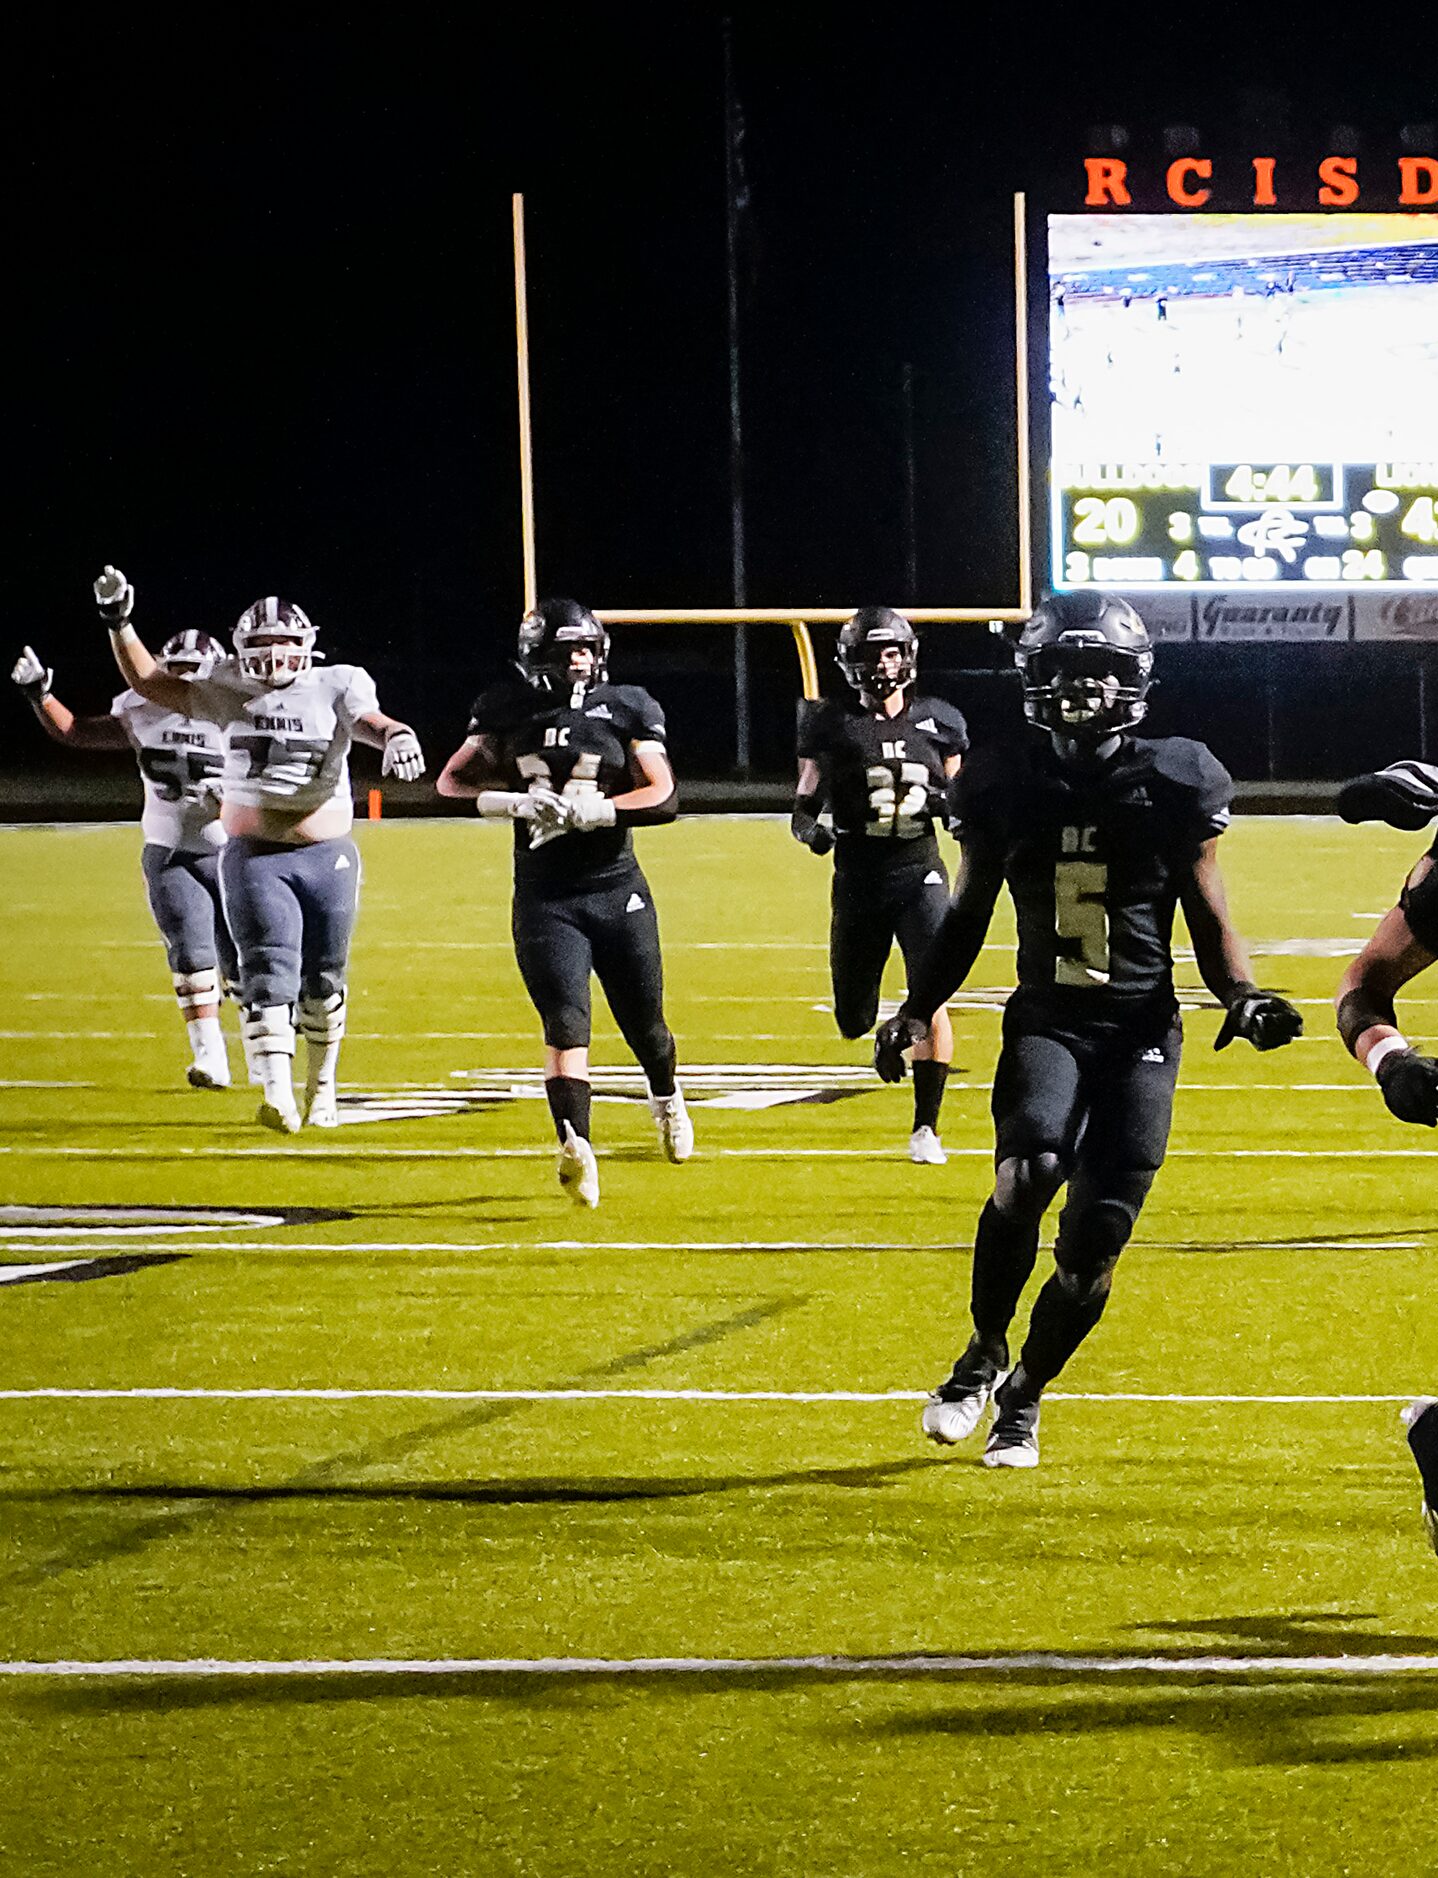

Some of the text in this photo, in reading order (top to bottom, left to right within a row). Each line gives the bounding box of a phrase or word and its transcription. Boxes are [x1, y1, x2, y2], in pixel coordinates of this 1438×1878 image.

[1225, 464, 1318, 501] 4:44
[1073, 497, 1138, 543] 20
[1172, 549, 1199, 581] 4
[1342, 549, 1385, 580] 24
[1054, 862, 1111, 987] 5
